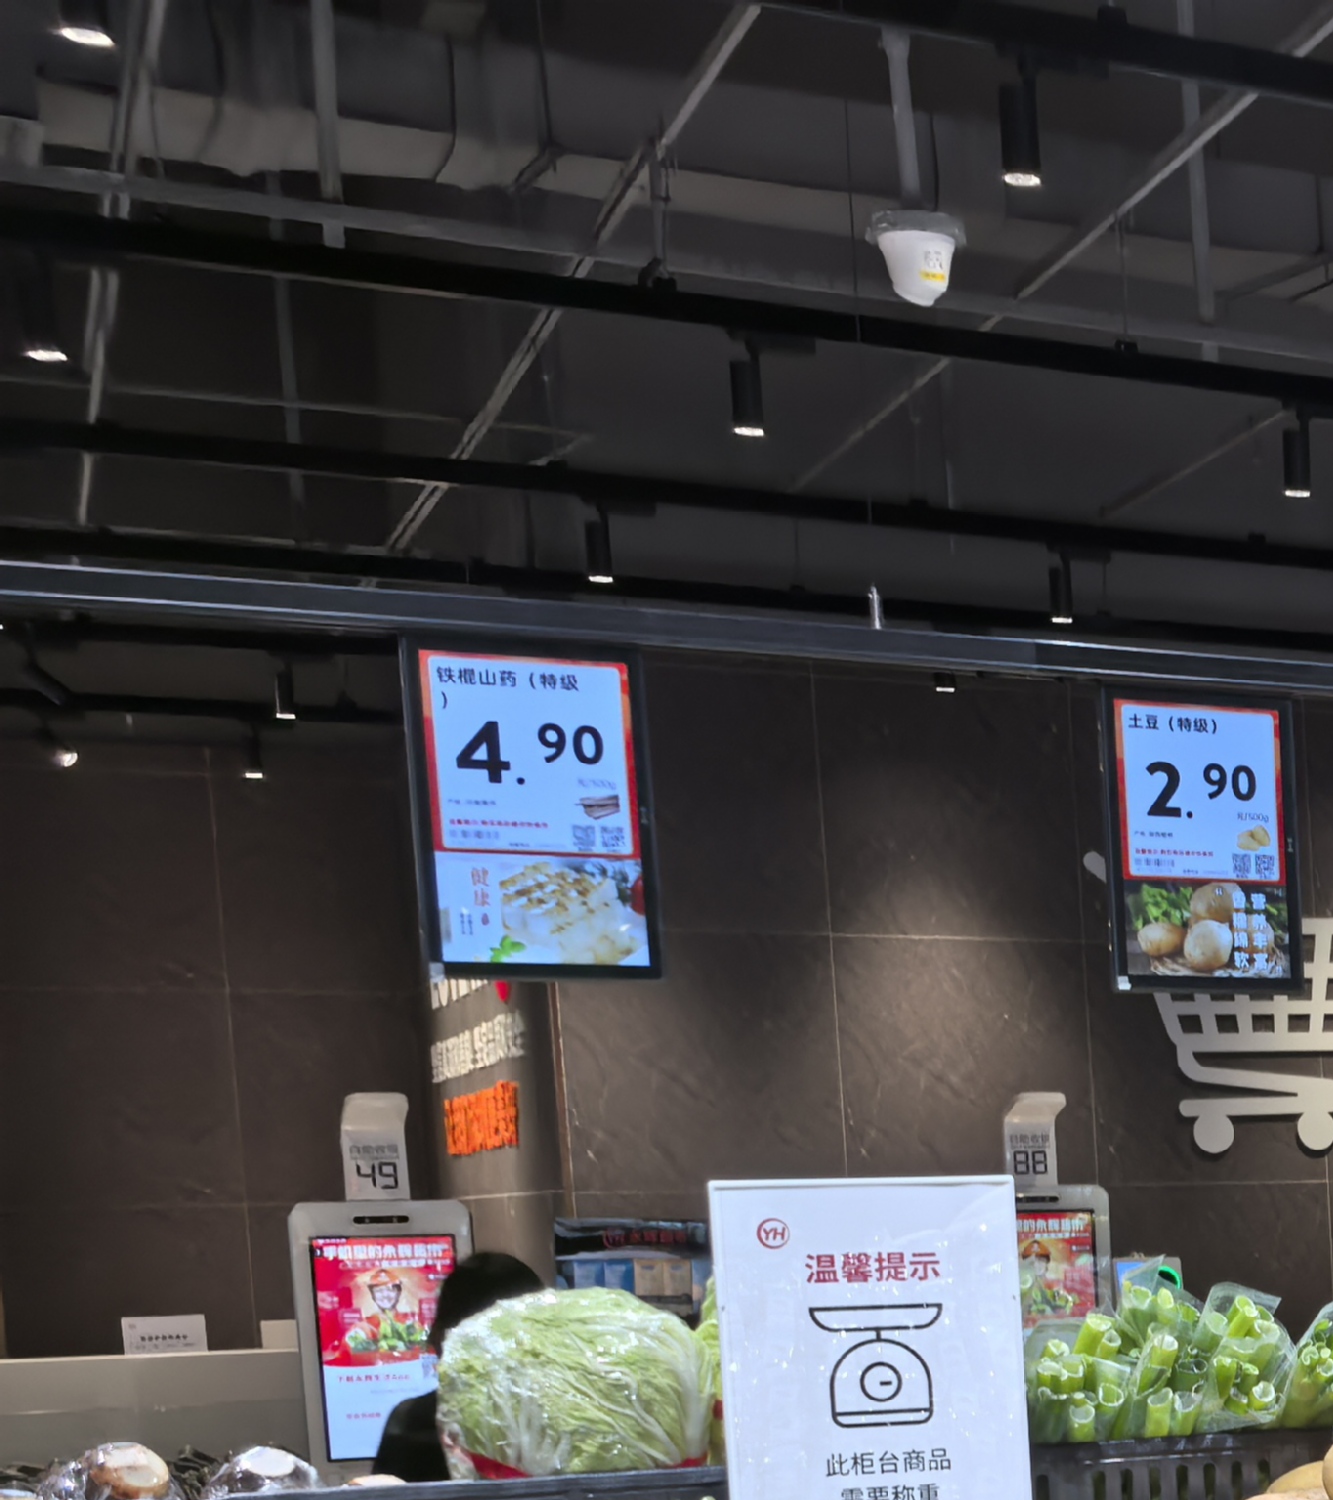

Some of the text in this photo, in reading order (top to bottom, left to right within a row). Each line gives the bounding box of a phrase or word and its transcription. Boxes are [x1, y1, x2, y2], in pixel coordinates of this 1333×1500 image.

[356, 1161, 399, 1189] 49
[804, 1251, 941, 1284] 温馨提示
[825, 1447, 953, 1478] 此柜台商品
